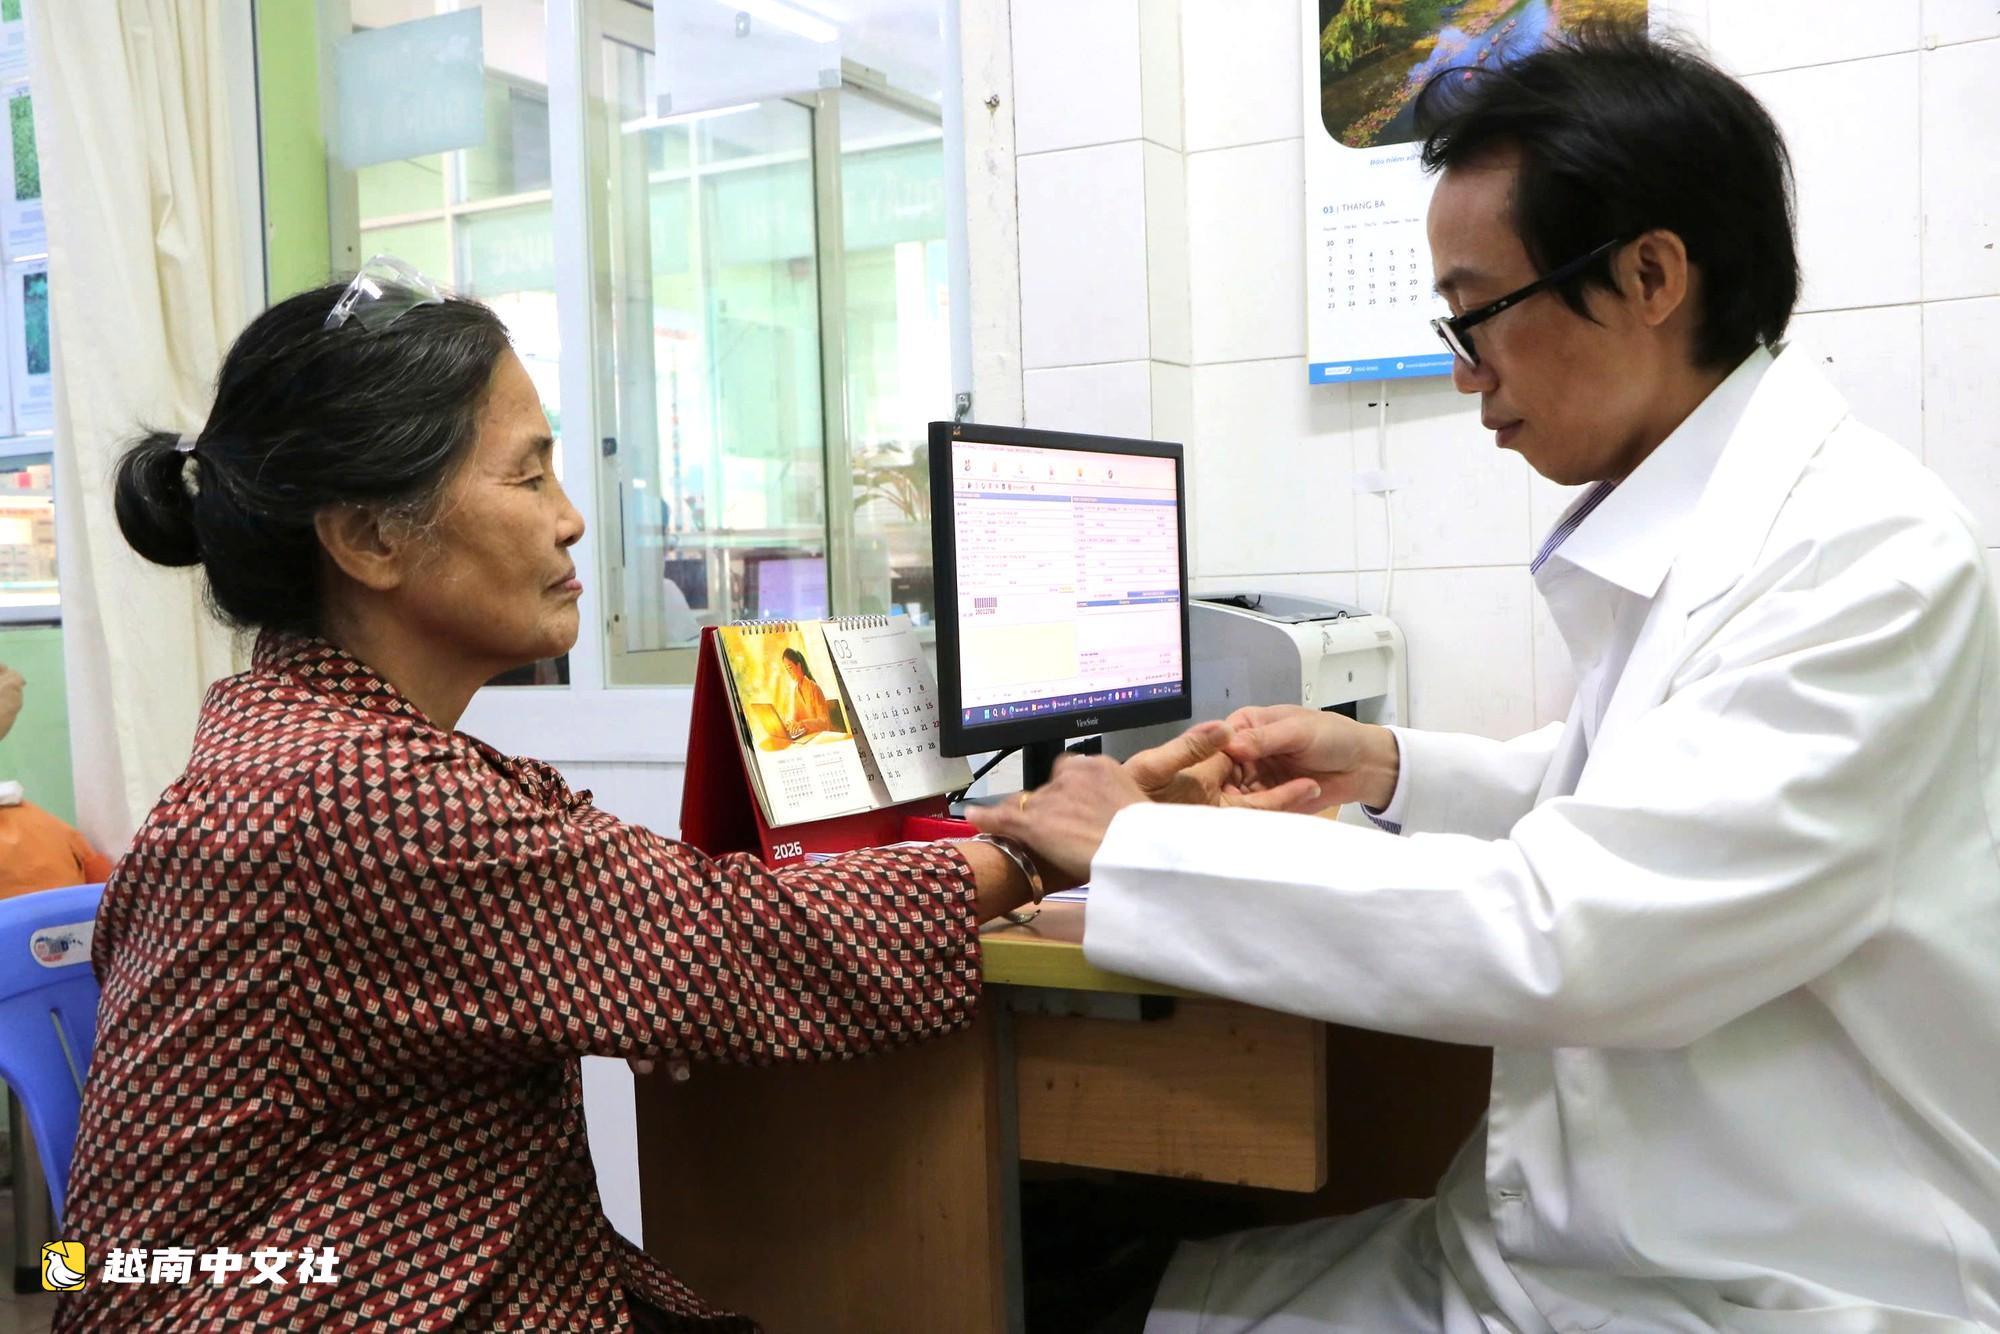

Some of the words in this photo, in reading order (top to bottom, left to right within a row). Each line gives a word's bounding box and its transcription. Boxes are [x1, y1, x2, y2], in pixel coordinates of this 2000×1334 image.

[1323, 206, 1333, 214] 03
[834, 640, 853, 659] 03
[773, 841, 803, 861] 2026
